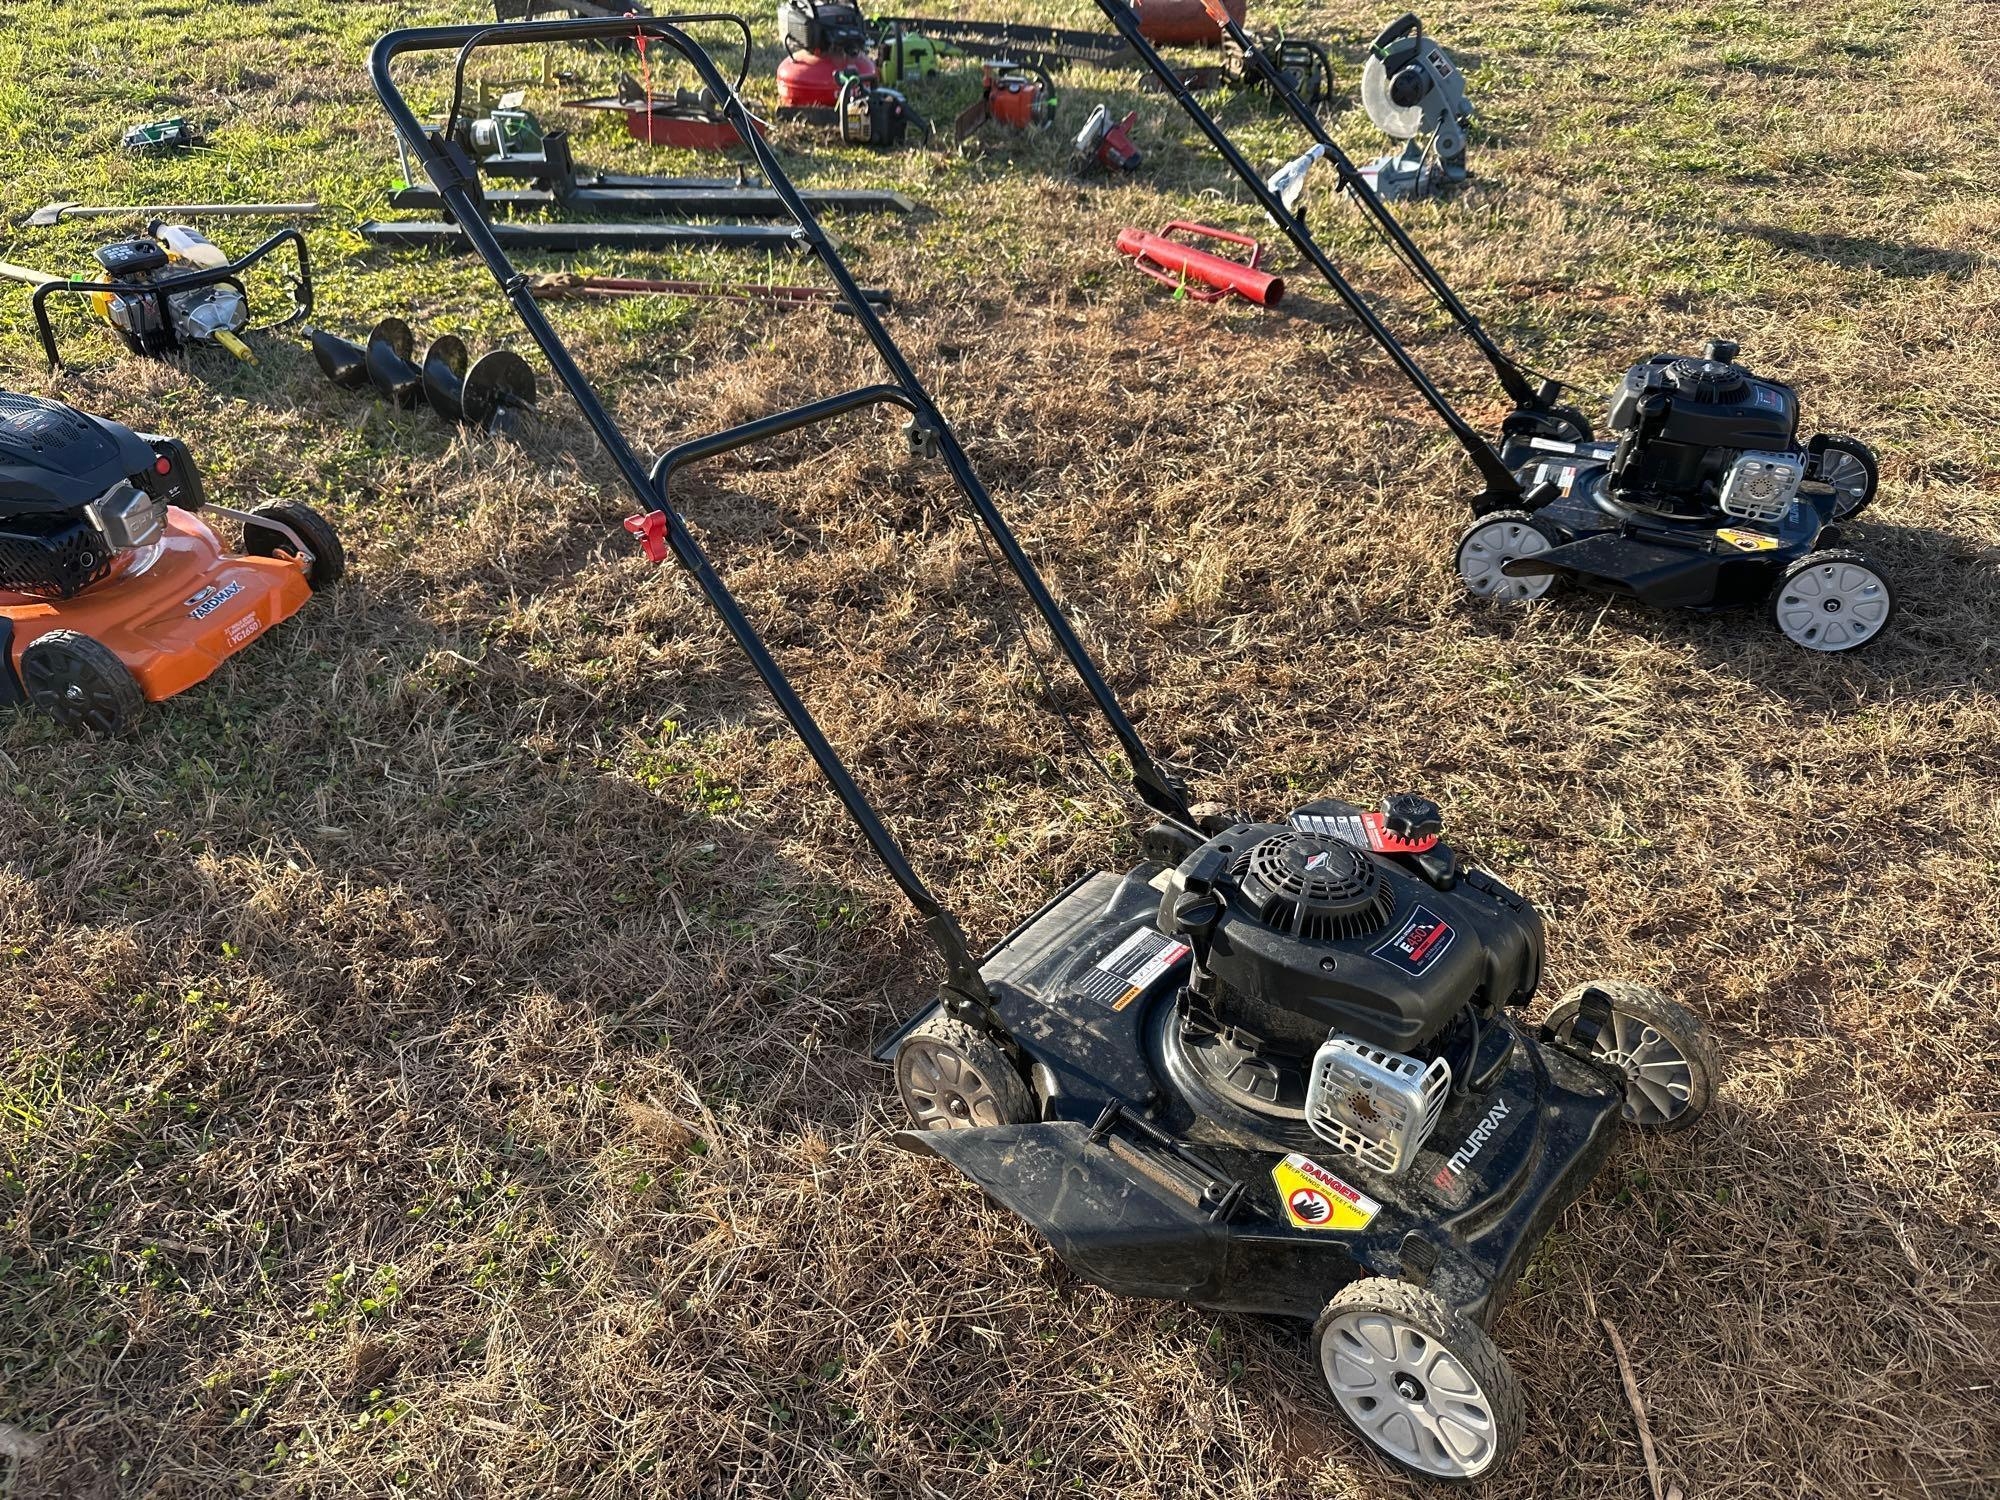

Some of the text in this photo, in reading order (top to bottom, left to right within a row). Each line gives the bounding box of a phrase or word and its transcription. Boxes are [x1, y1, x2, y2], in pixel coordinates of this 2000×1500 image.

[188, 580, 245, 619] YARDMAX
[1400, 927, 1428, 954] E450
[1446, 1098, 1510, 1175] MURRAY
[1284, 1163, 1367, 1217] KEEP HANDS and FEET AWAY
[1301, 1162, 1361, 1204] DANGER
